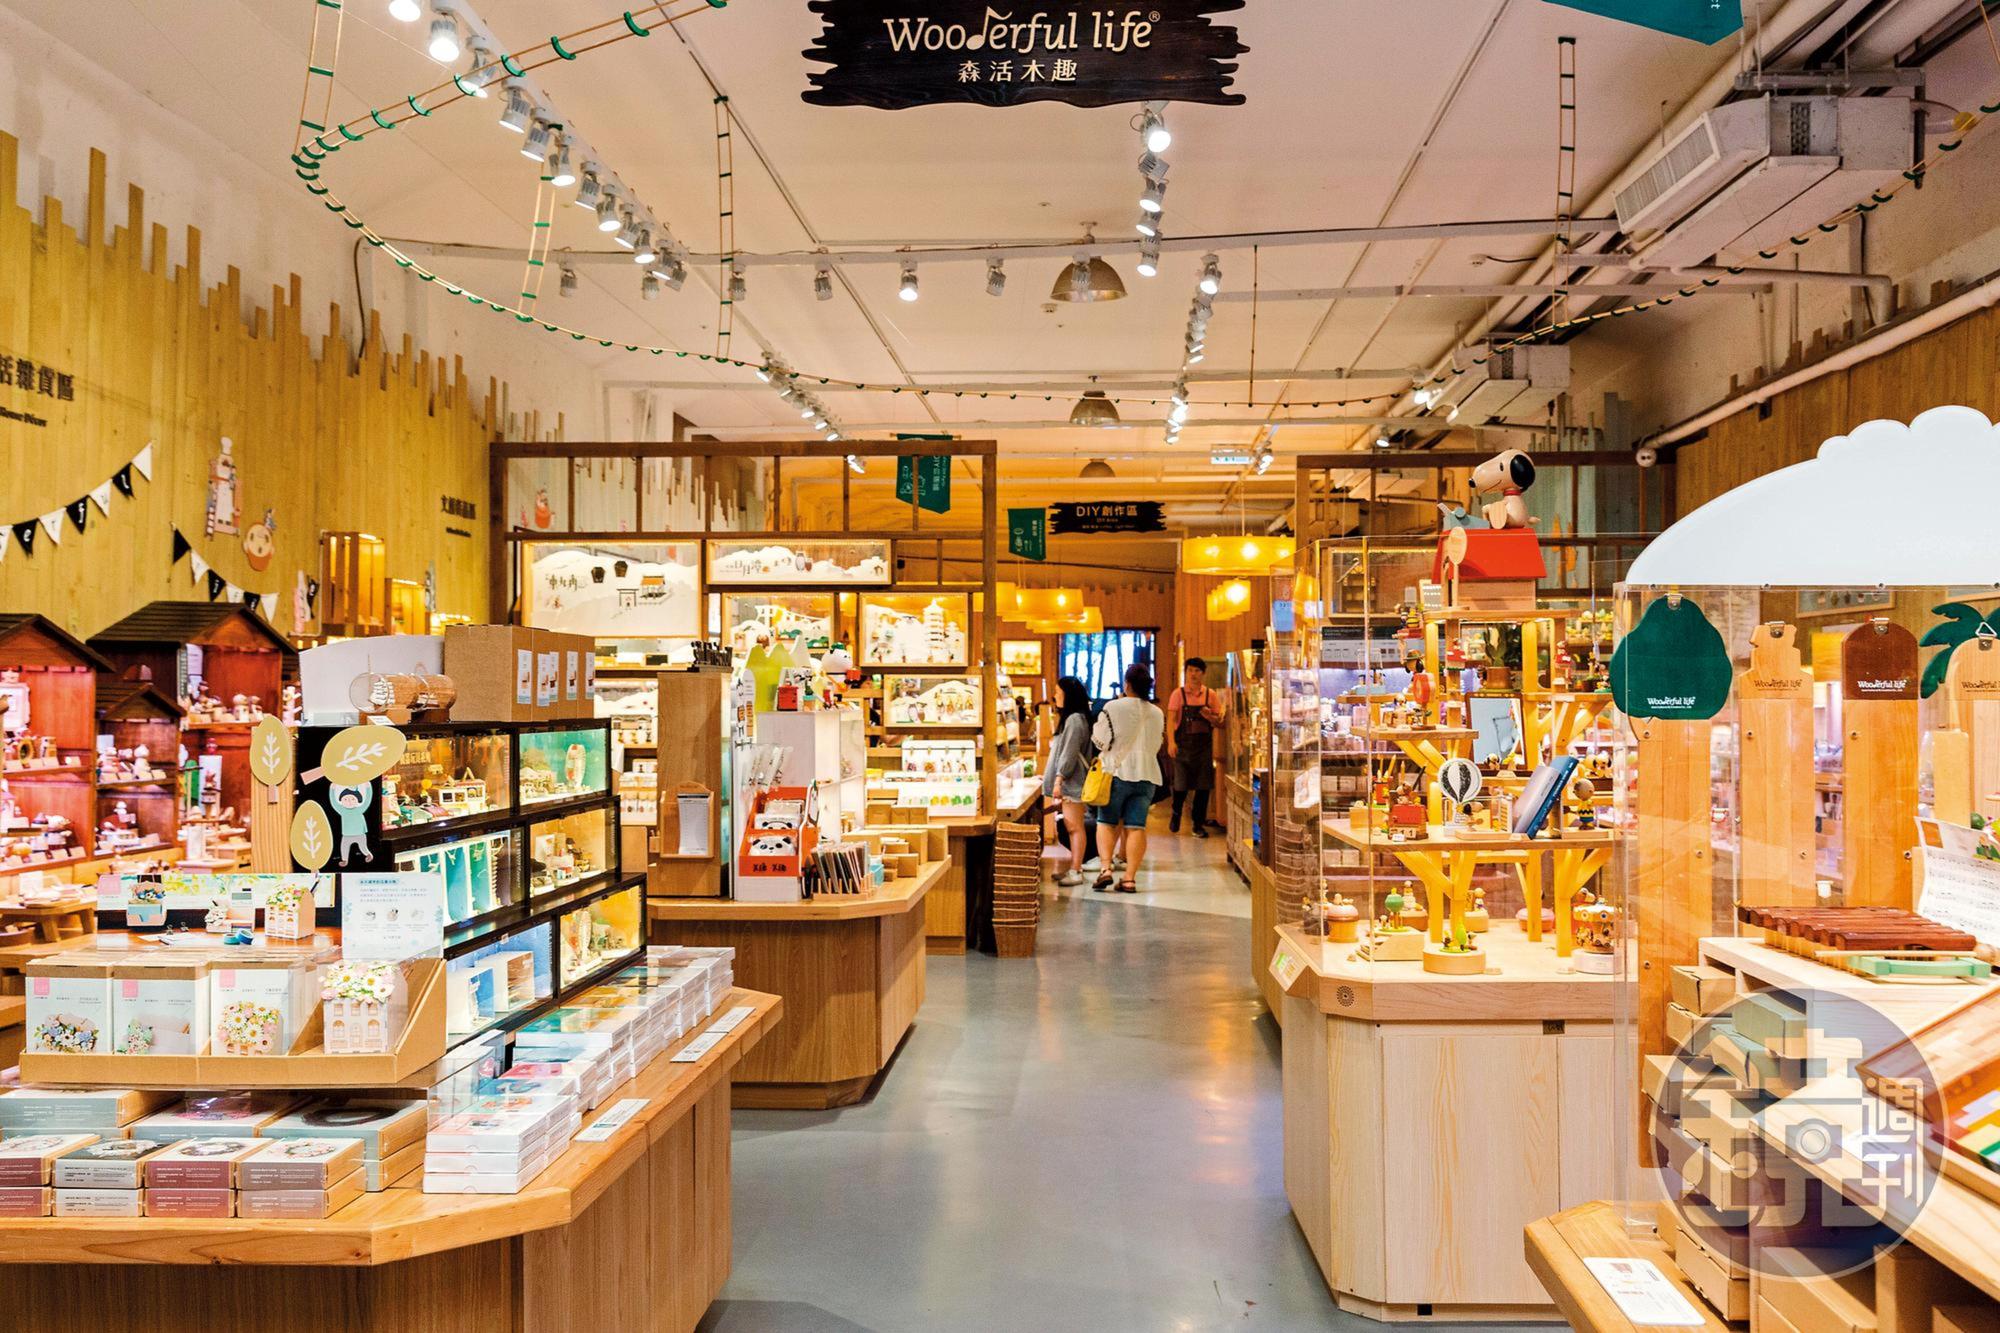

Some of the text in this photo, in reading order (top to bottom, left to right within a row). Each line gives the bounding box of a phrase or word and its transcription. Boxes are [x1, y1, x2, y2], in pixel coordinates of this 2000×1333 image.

[957, 58, 1078, 83] 森活木趣
[1076, 505, 1138, 517] DIY創作區
